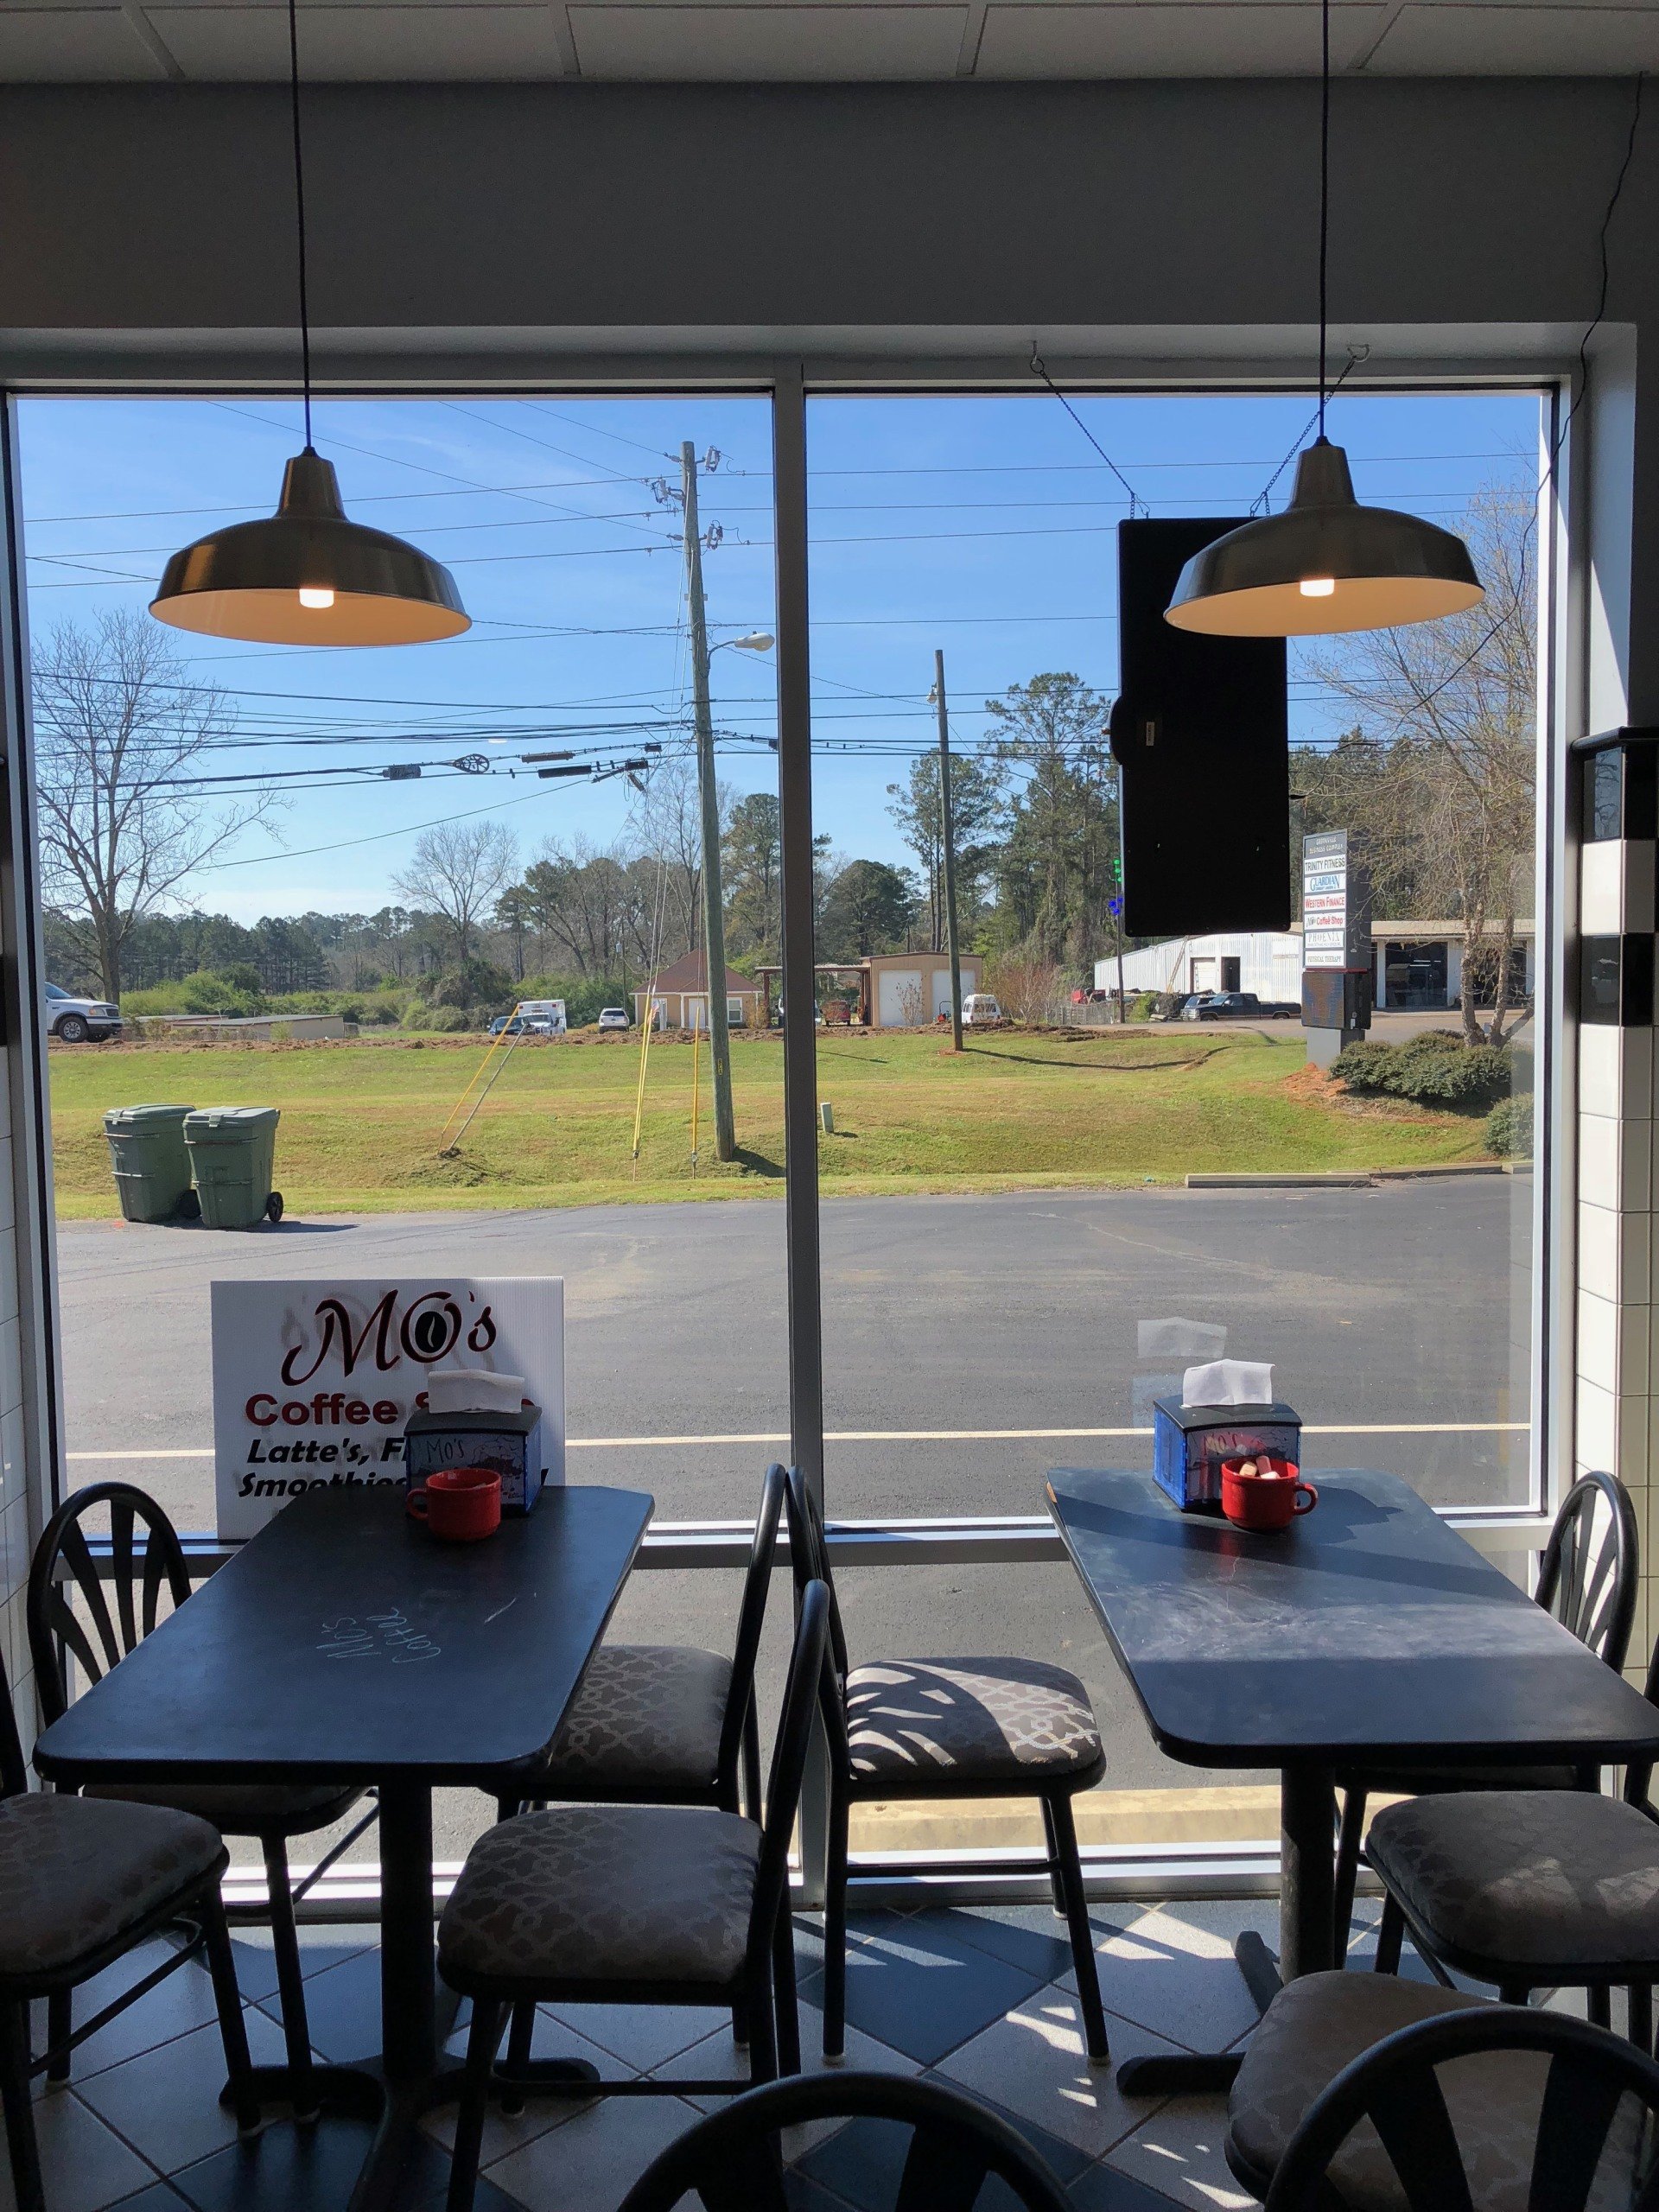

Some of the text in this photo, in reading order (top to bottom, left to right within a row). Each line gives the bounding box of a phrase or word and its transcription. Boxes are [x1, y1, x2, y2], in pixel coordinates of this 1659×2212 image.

[1305, 857, 1345, 872] TRINITY FITNESS
[1310, 875, 1340, 892] GUARDIAN
[1316, 916, 1331, 925] Coffee
[1331, 916, 1344, 926] Shop
[1308, 931, 1340, 943] PHOENIX
[245, 1393, 398, 1426] Coffee
[246, 1437, 371, 1466] Latte's,
